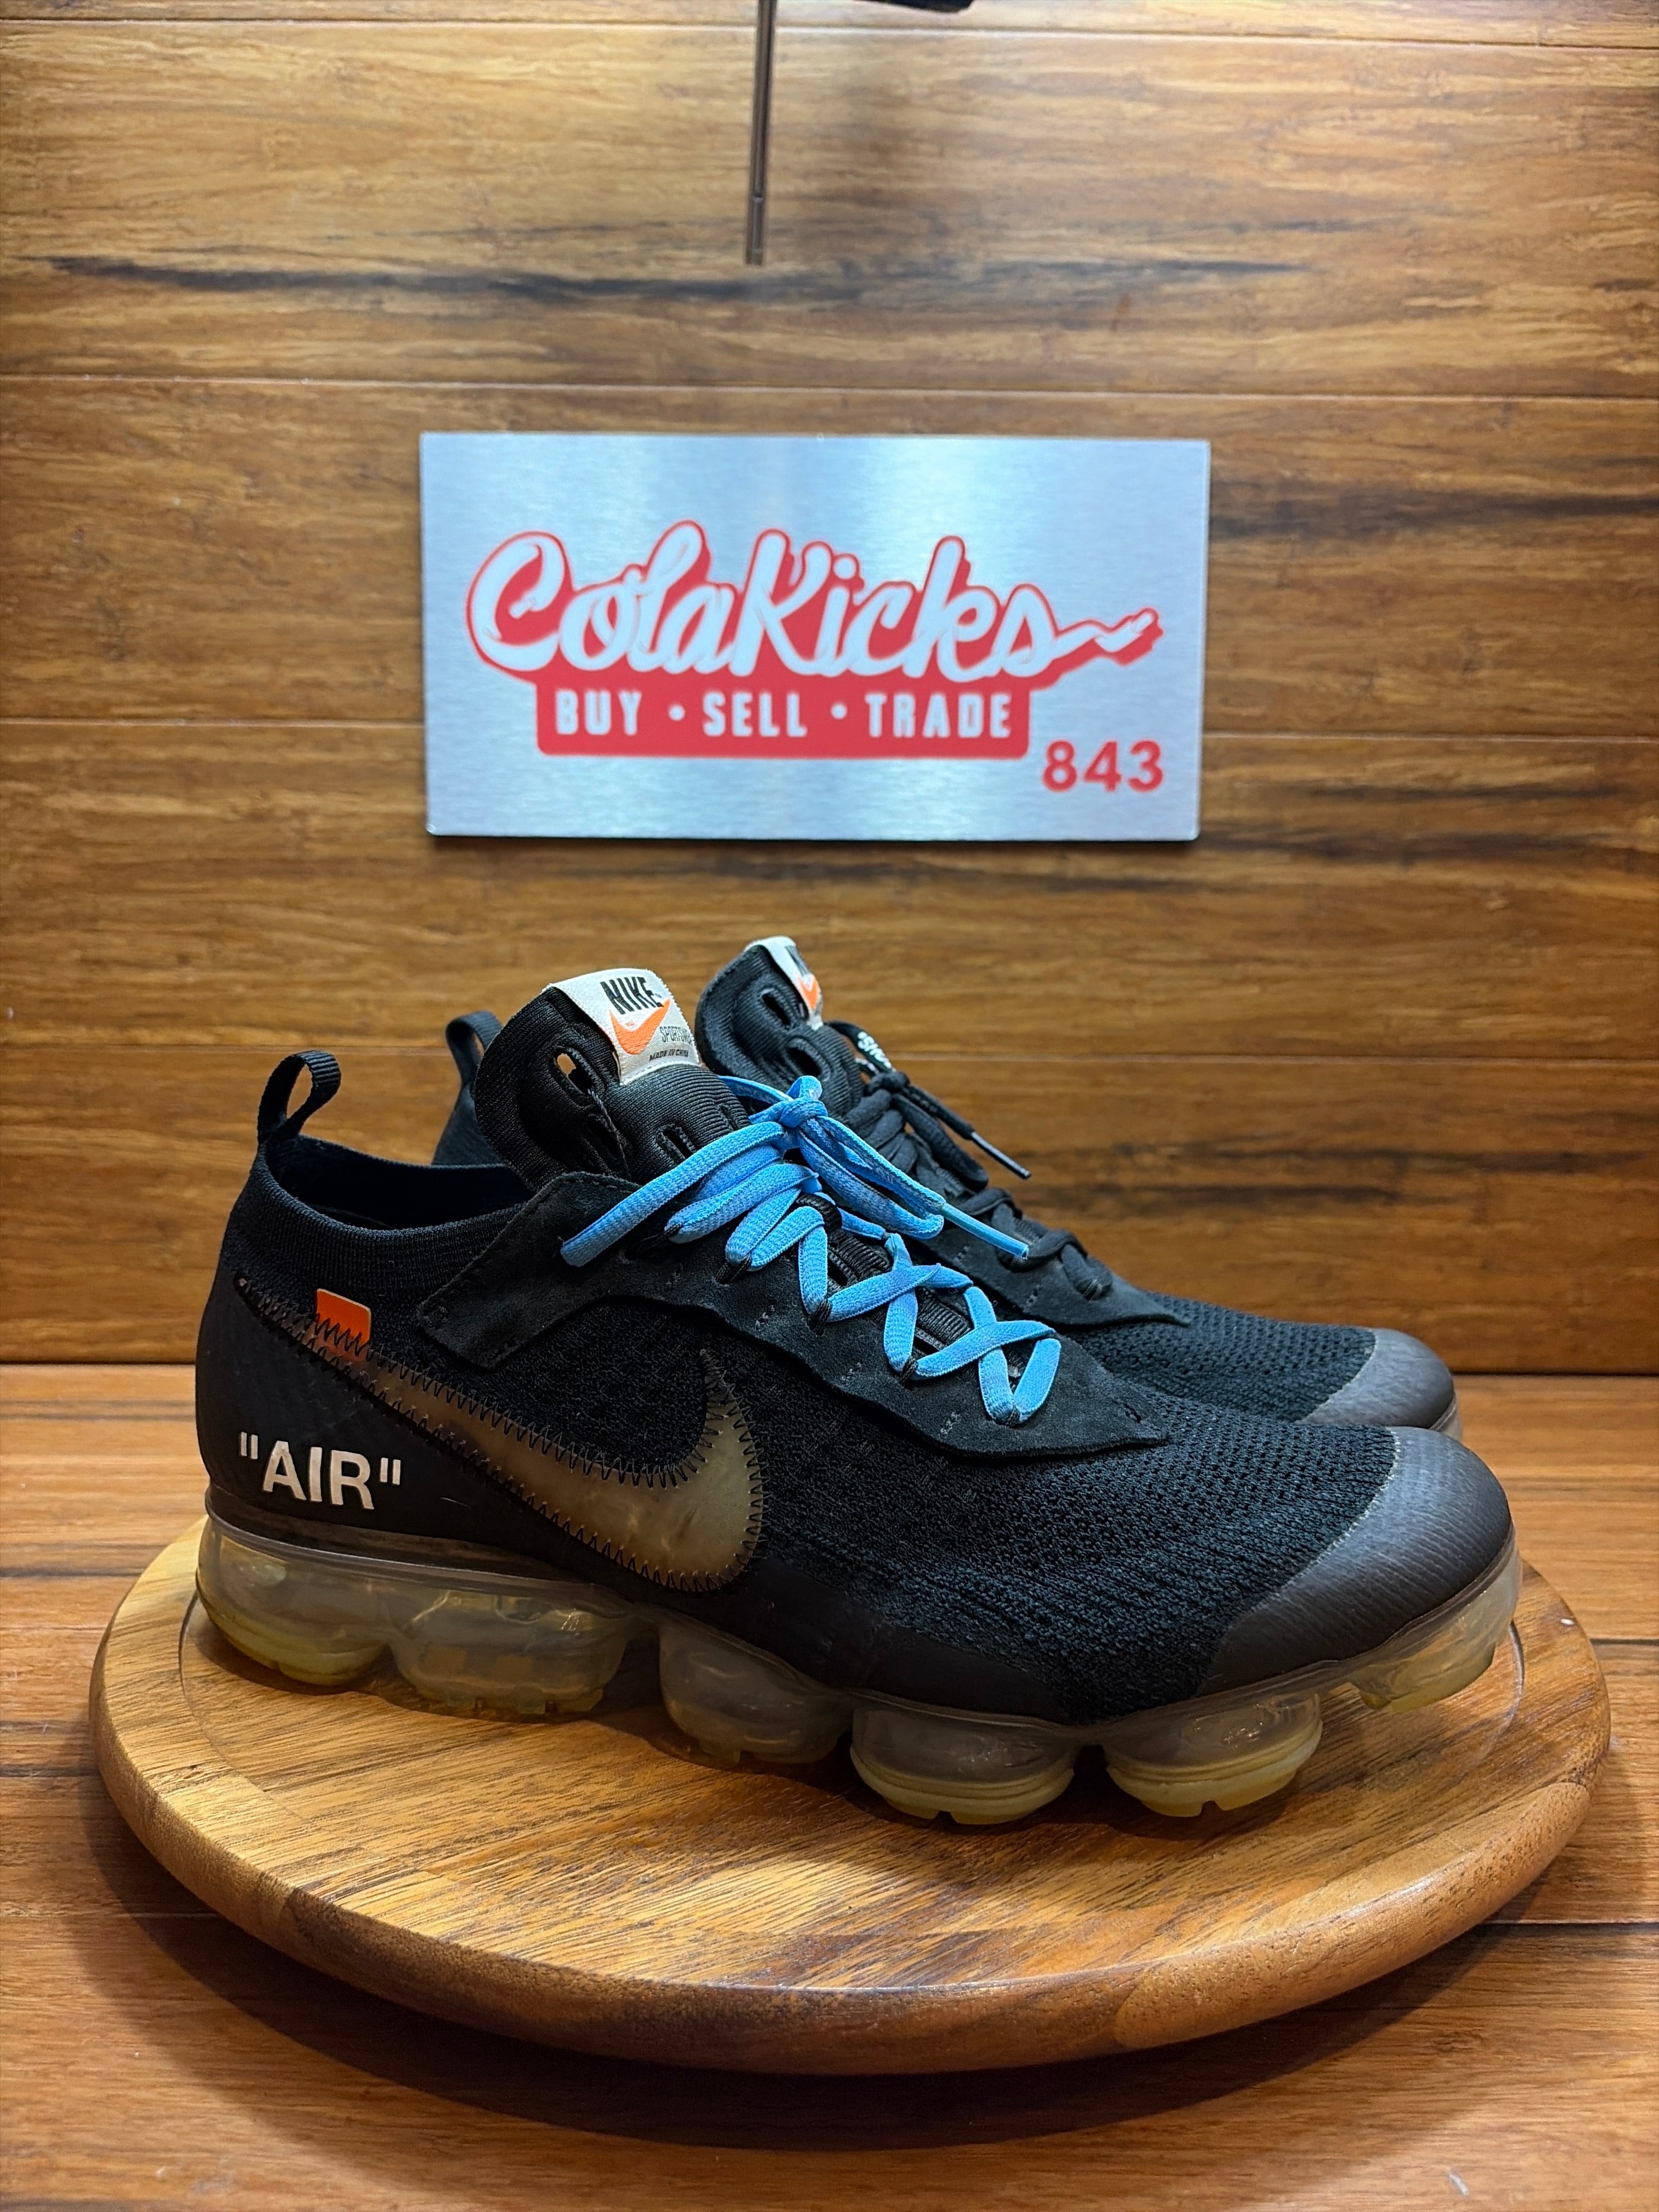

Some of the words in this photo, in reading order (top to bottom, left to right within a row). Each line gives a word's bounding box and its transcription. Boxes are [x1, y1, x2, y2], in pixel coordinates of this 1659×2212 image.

[466, 520, 1162, 682] ColaKicks
[555, 689, 642, 736] BUY
[702, 691, 808, 738] SELL
[865, 693, 1012, 738] TRADE
[1042, 739, 1164, 793] 843
[600, 976, 664, 1015] NIKE
[649, 1049, 667, 1062] MADE
[240, 1431, 401, 1510] "AIR"
